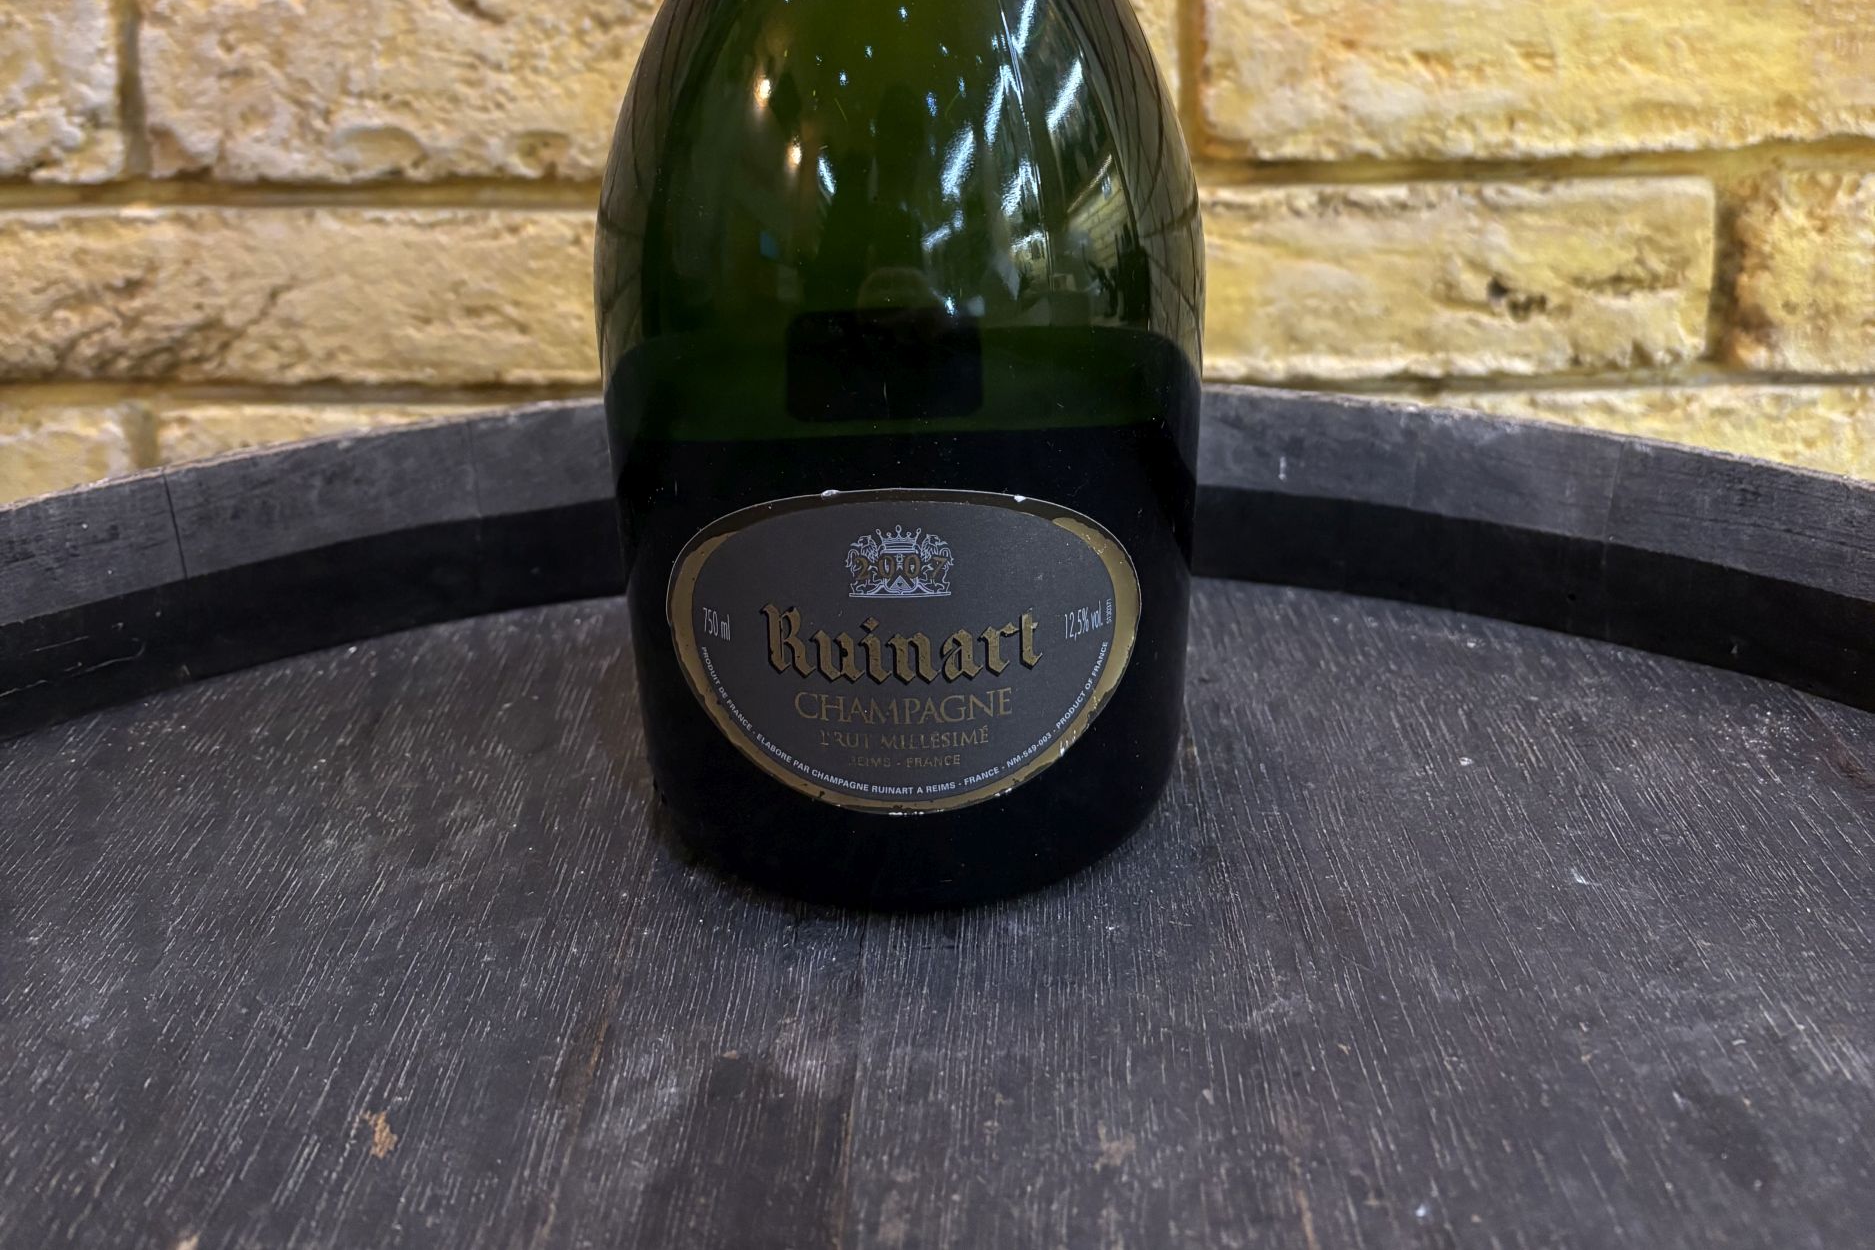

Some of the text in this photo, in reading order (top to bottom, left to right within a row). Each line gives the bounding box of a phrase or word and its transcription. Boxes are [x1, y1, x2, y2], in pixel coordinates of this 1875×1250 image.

[855, 554, 948, 582] 2007
[702, 607, 731, 642] 750 ml
[1064, 606, 1089, 642] 12,5%
[759, 603, 1044, 685] Ruinart
[701, 646, 721, 686] PRODUIT
[718, 686, 729, 699] DE
[726, 699, 754, 731] FRANCE
[756, 733, 793, 763] ELABORE
[792, 759, 810, 774] PAR
[811, 769, 869, 792] CHAMPAGNE
[871, 785, 914, 796] RUINART
[916, 786, 924, 795] A
[925, 781, 956, 793] REIMS
[963, 766, 1000, 786] FRANCE
[1055, 690, 1087, 730] PRODUCT
[1084, 677, 1094, 691] OF
[1091, 641, 1109, 678] FRANCE
[794, 687, 1013, 725] CHAMPAGNE
[906, 754, 961, 768] FRANCE
